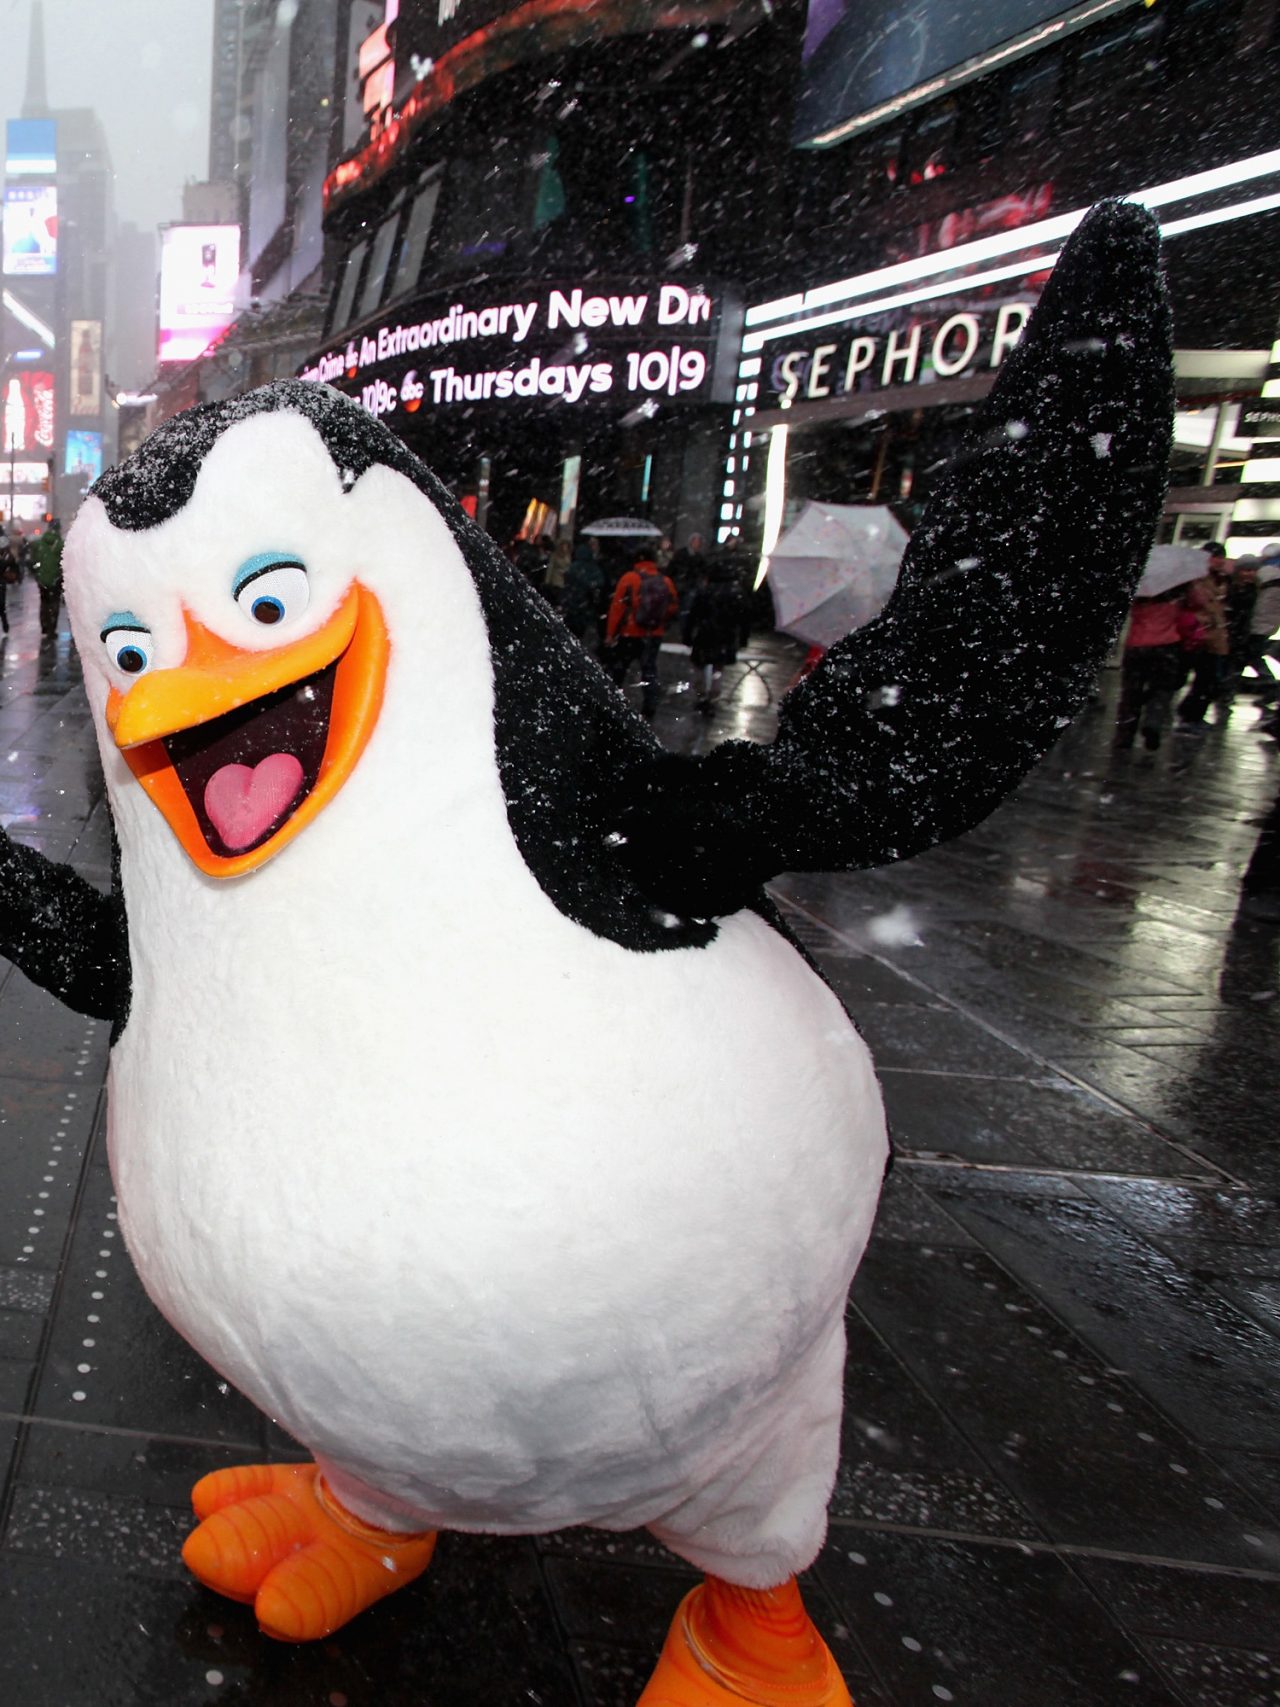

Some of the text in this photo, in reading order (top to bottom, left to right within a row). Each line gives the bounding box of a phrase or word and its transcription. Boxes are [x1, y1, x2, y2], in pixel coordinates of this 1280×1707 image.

[359, 337, 376, 367] An
[377, 303, 537, 361] Extraordinary
[548, 288, 648, 329] New
[430, 358, 613, 403] Thursdays
